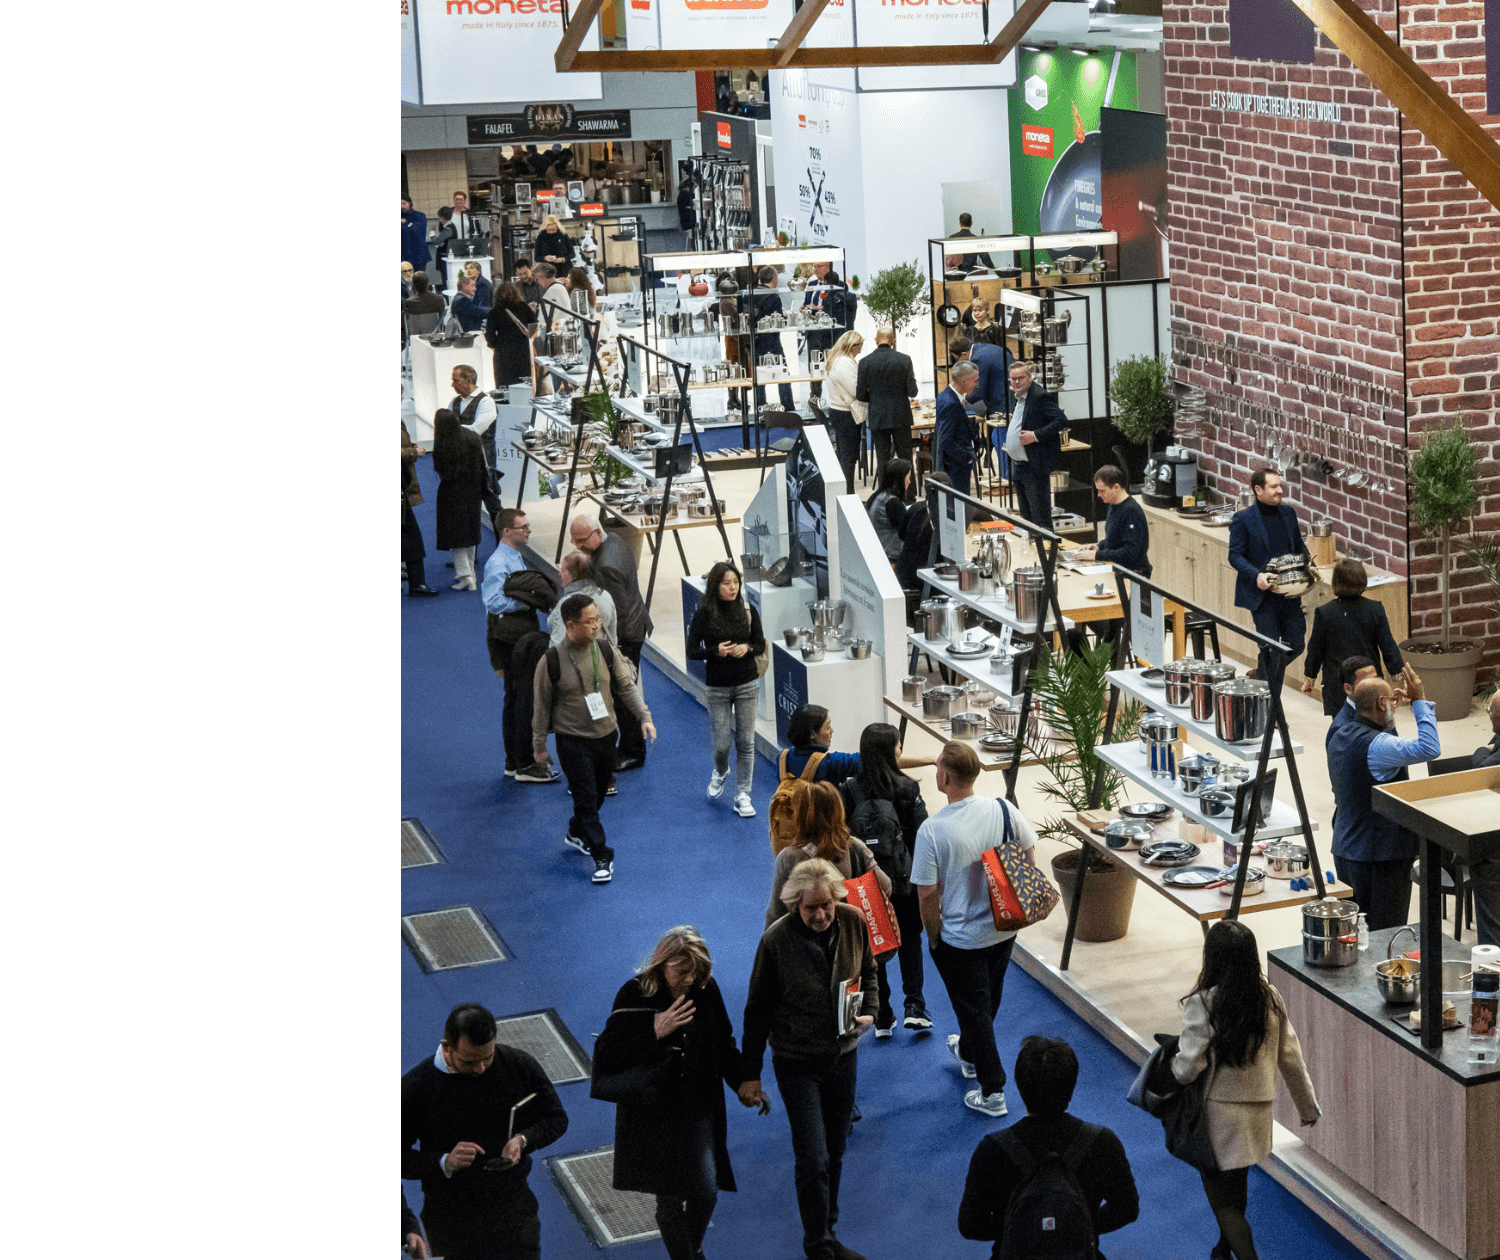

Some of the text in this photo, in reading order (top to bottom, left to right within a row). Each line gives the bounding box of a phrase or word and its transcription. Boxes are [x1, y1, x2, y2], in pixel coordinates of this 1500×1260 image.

[446, 0, 570, 15] moneta
[924, 12, 940, 20] italy
[495, 20, 513, 30] italy
[515, 20, 534, 28] since
[1226, 91, 1243, 111] COOK
[1243, 93, 1252, 112] UP
[1252, 94, 1285, 116] TOGETHER
[1286, 98, 1291, 116] A
[1291, 98, 1317, 119] BETTER
[1317, 101, 1341, 122] WORLD
[485, 123, 514, 135] FALAFEL
[577, 119, 619, 131] SHAWARMA
[1025, 131, 1050, 143] moneta
[809, 146, 821, 160] 70%
[799, 184, 811, 198] 50%
[982, 862, 1006, 910] MARUSHIN
[856, 884, 879, 935] MARUSHIN
